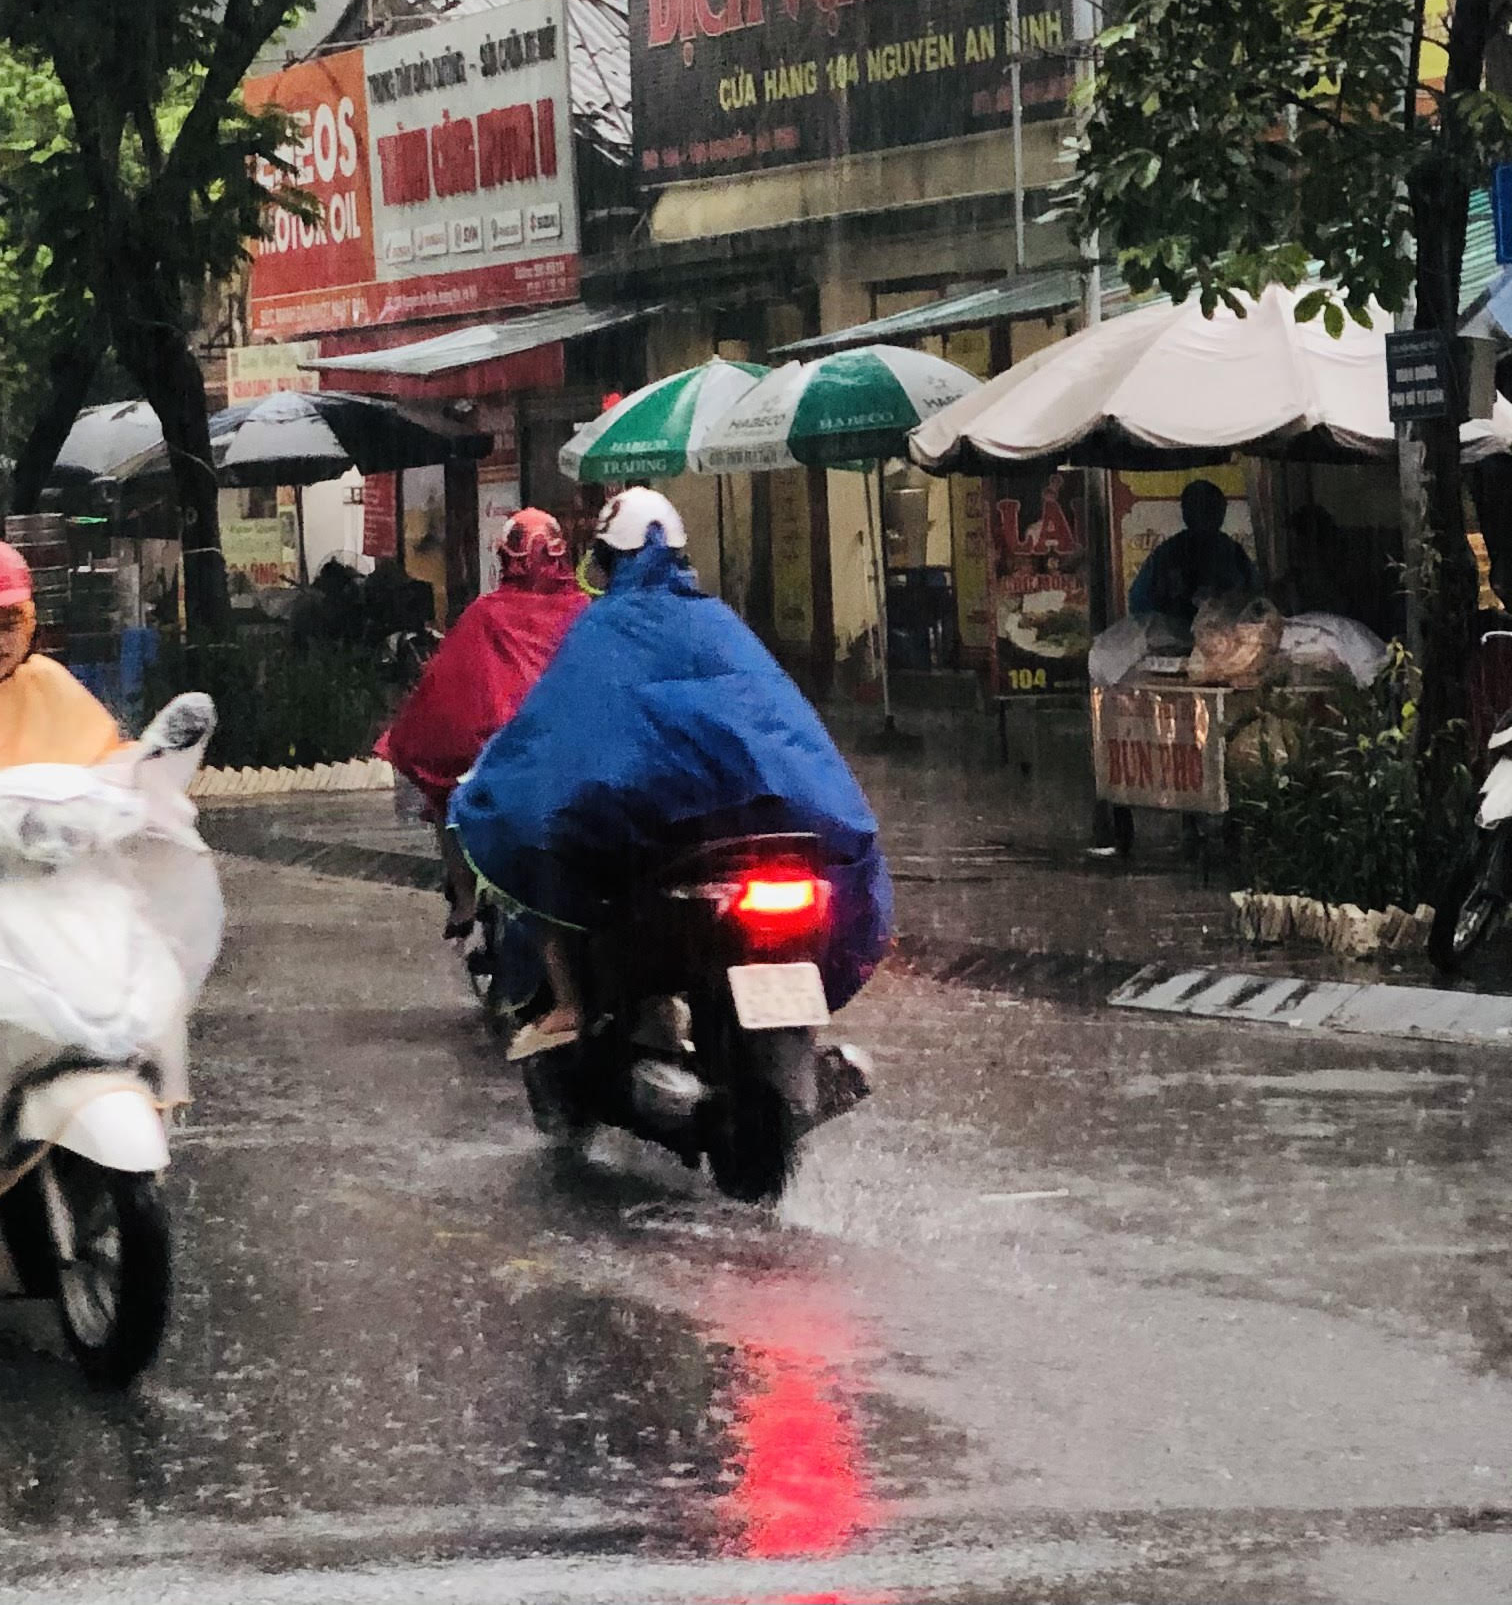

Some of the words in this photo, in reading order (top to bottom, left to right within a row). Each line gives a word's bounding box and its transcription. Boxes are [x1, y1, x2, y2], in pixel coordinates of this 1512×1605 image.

[719, 65, 757, 112] CỬA
[764, 57, 818, 102] HÀNG
[826, 52, 860, 90] 104
[964, 25, 996, 64] AN
[329, 191, 362, 245] OIL
[602, 458, 668, 476] TRADING
[1008, 668, 1047, 690] 104
